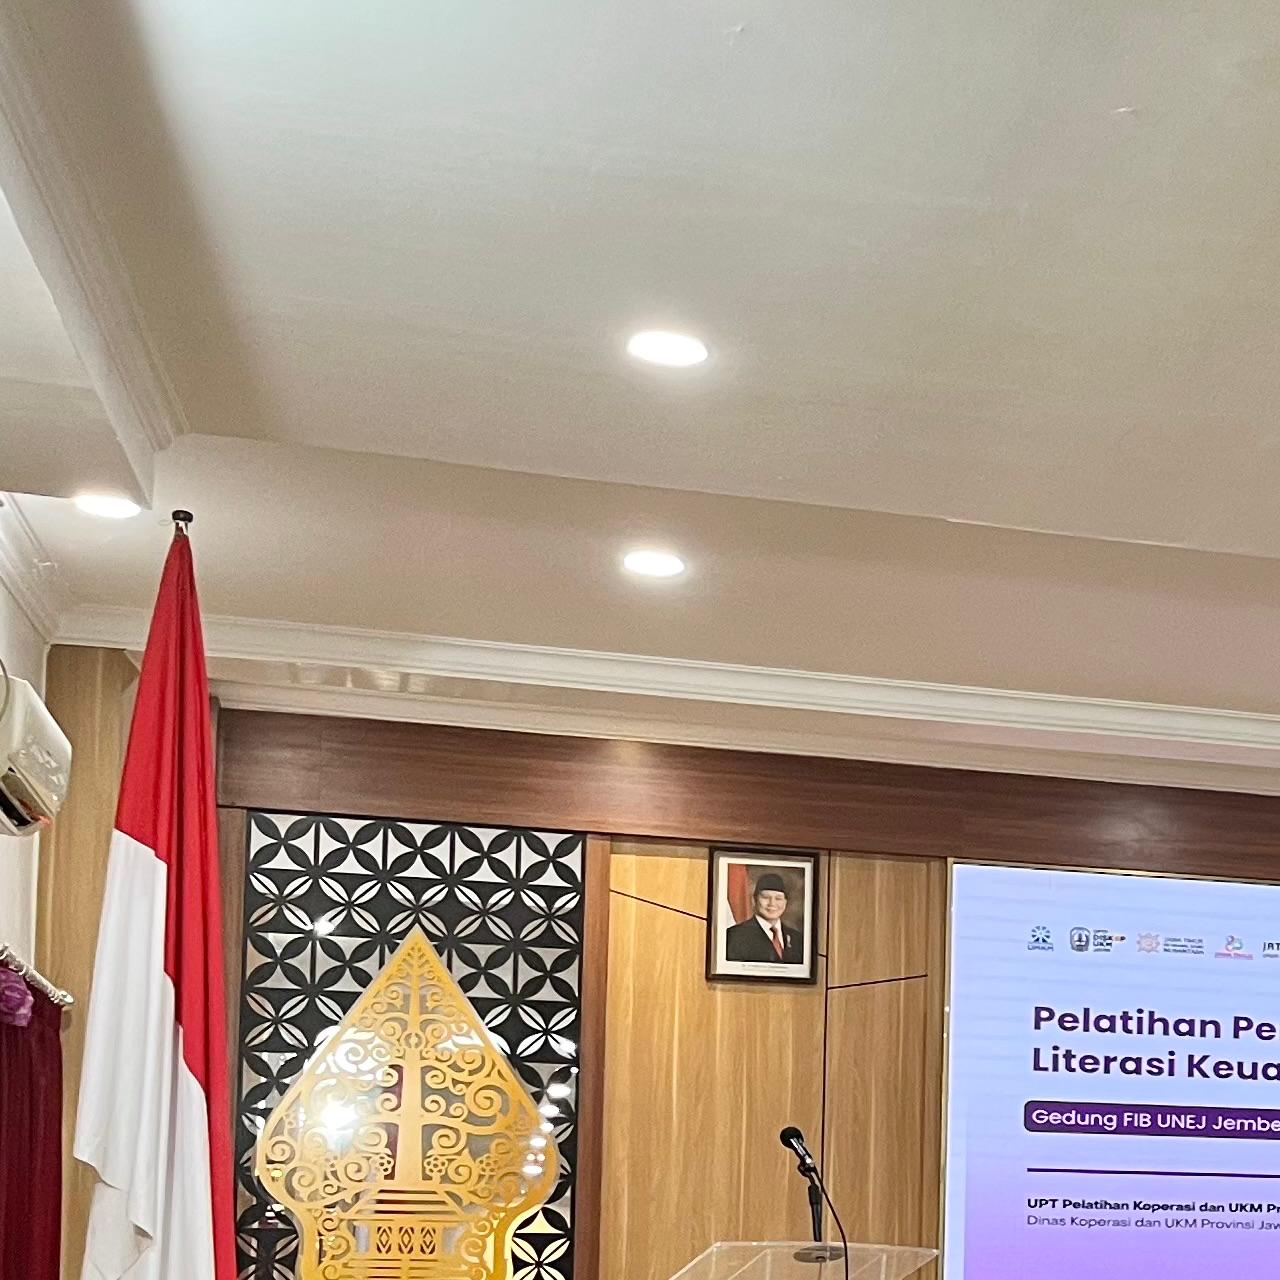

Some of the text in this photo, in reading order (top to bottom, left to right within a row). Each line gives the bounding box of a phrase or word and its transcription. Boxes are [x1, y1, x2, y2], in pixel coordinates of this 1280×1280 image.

[1033, 1006, 1221, 1039] Pelatihan
[1033, 1045, 1176, 1077] Literasi
[1031, 1109, 1117, 1131] Gedung
[1123, 1112, 1152, 1128] FIB
[1157, 1113, 1207, 1130] UNEJ
[1027, 1198, 1059, 1209] UPT
[1062, 1199, 1130, 1211] Pelatihan
[1133, 1200, 1196, 1213] Koperasi
[1199, 1202, 1225, 1213] dan
[1228, 1203, 1263, 1213] UKM
[1027, 1215, 1066, 1226] Dinas
[1070, 1216, 1131, 1229] Koperasi
[1135, 1217, 1161, 1228] dan
[1164, 1218, 1197, 1229] UKM
[1201, 1218, 1255, 1230] Provinsi
